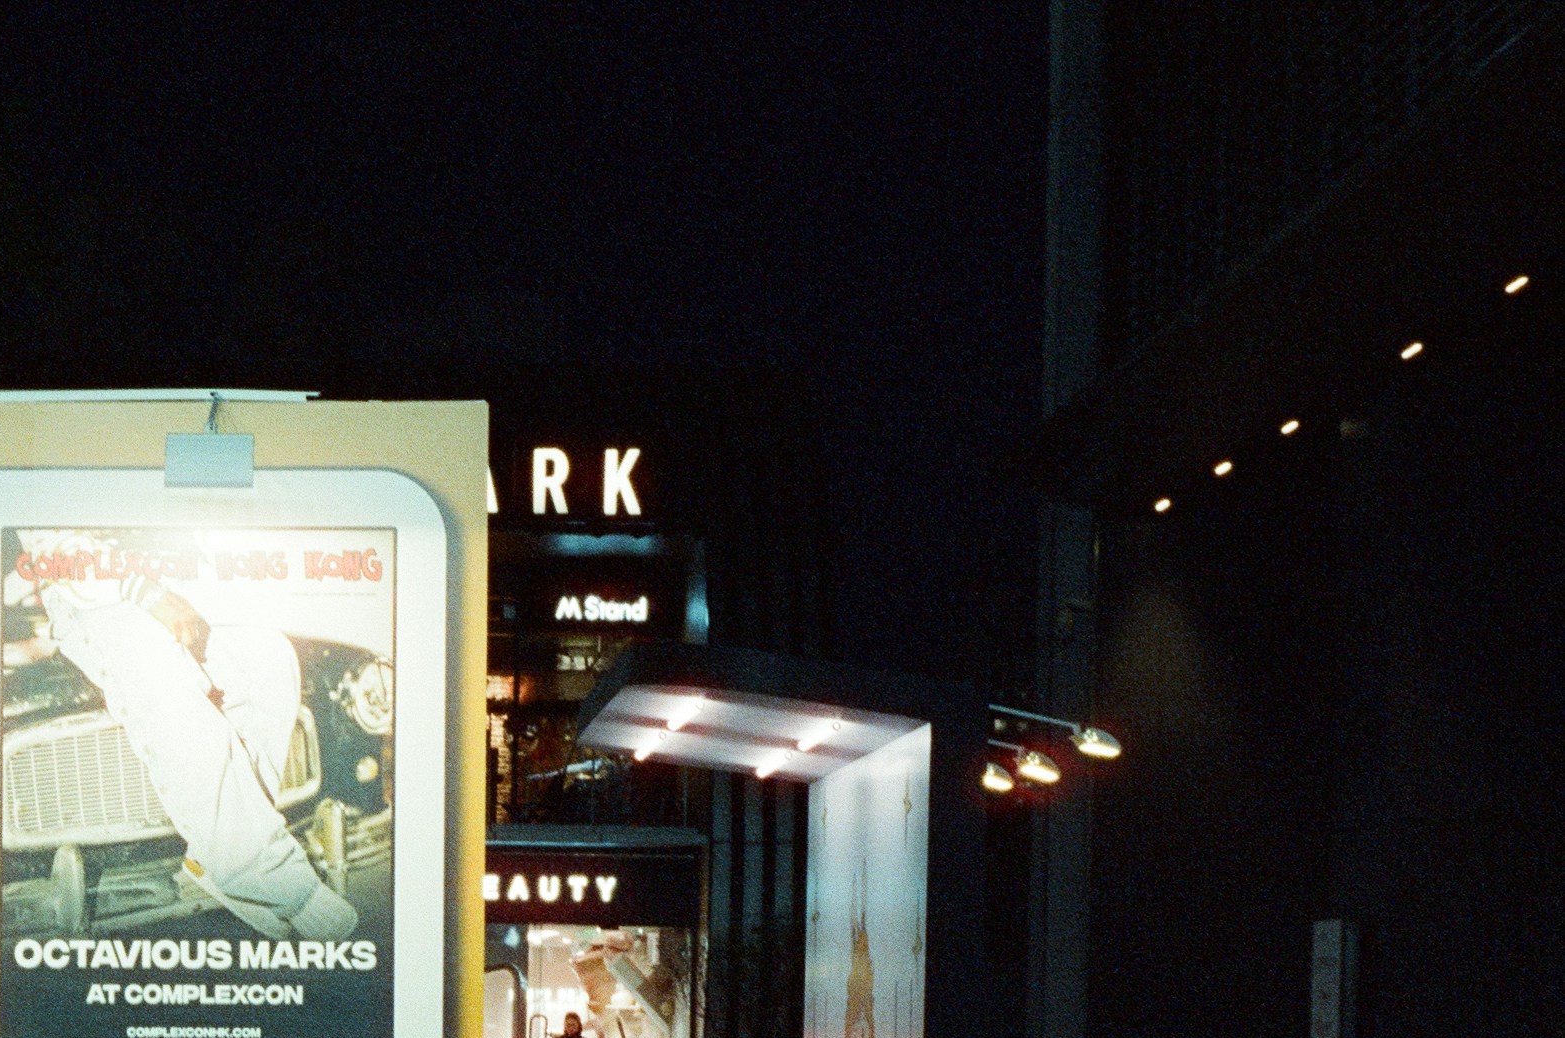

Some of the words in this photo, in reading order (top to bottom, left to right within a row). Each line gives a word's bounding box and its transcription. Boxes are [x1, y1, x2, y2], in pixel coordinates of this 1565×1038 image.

[585, 593, 649, 622] Stand
[13, 938, 233, 970] OCTAVIOUS
[239, 940, 377, 970] MARKS
[86, 983, 121, 1005] AT
[124, 983, 304, 1006] COMPLEXCON
[126, 1026, 262, 1038] COMPLEXCONHK.COM
